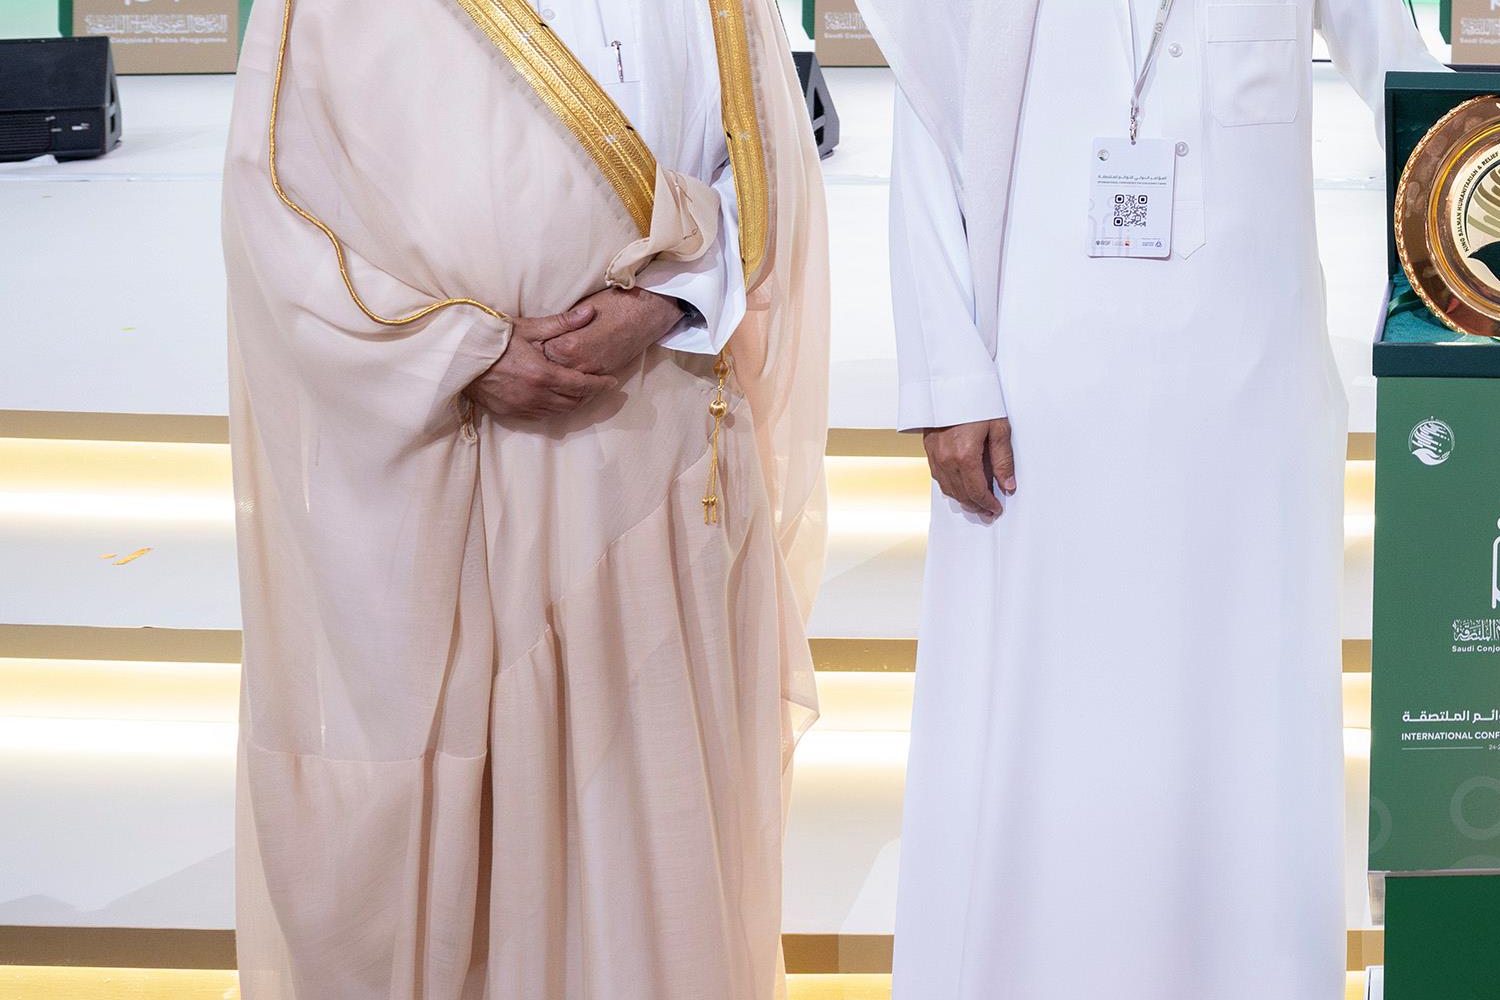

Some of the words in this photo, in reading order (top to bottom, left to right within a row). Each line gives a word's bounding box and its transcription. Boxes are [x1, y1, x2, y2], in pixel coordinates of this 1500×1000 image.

[1481, 151, 1499, 166] RELIEF
[1452, 645, 1475, 653] Saudi
[1402, 710, 1470, 722] الملتصقة
[1401, 732, 1473, 741] INTERNATIONAL
